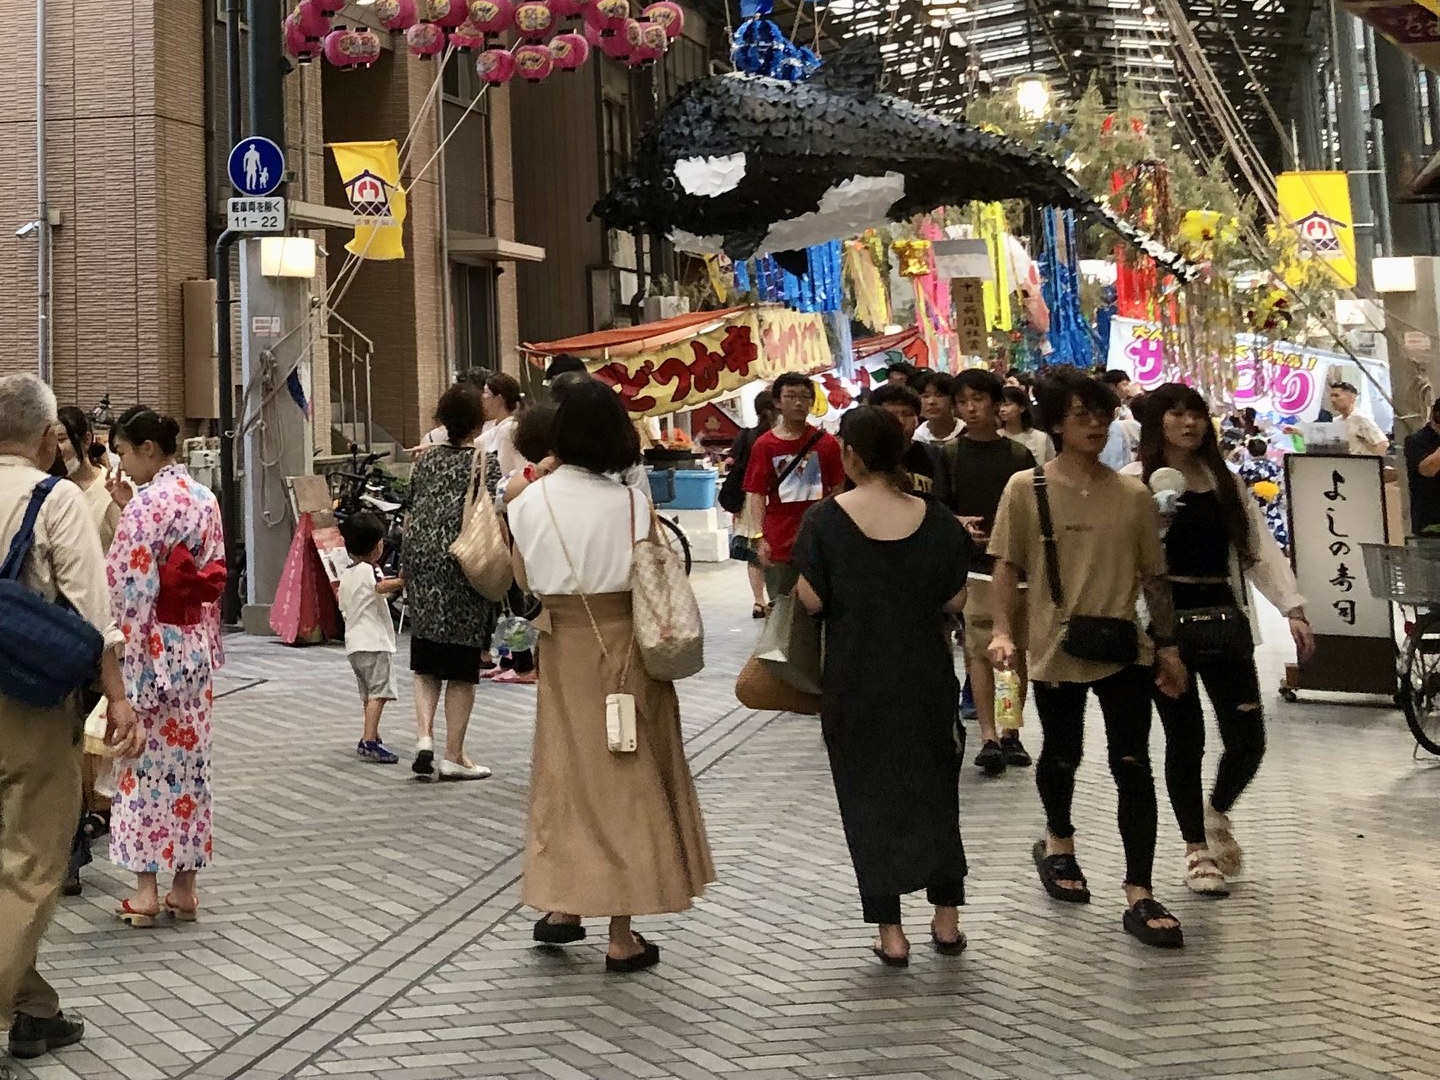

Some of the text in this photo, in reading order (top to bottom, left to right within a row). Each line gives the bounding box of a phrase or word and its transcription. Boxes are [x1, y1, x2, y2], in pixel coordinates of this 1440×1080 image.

[231, 201, 281, 213] 軽車両を除く
[1324, 470, 1356, 625] よしの寿司
